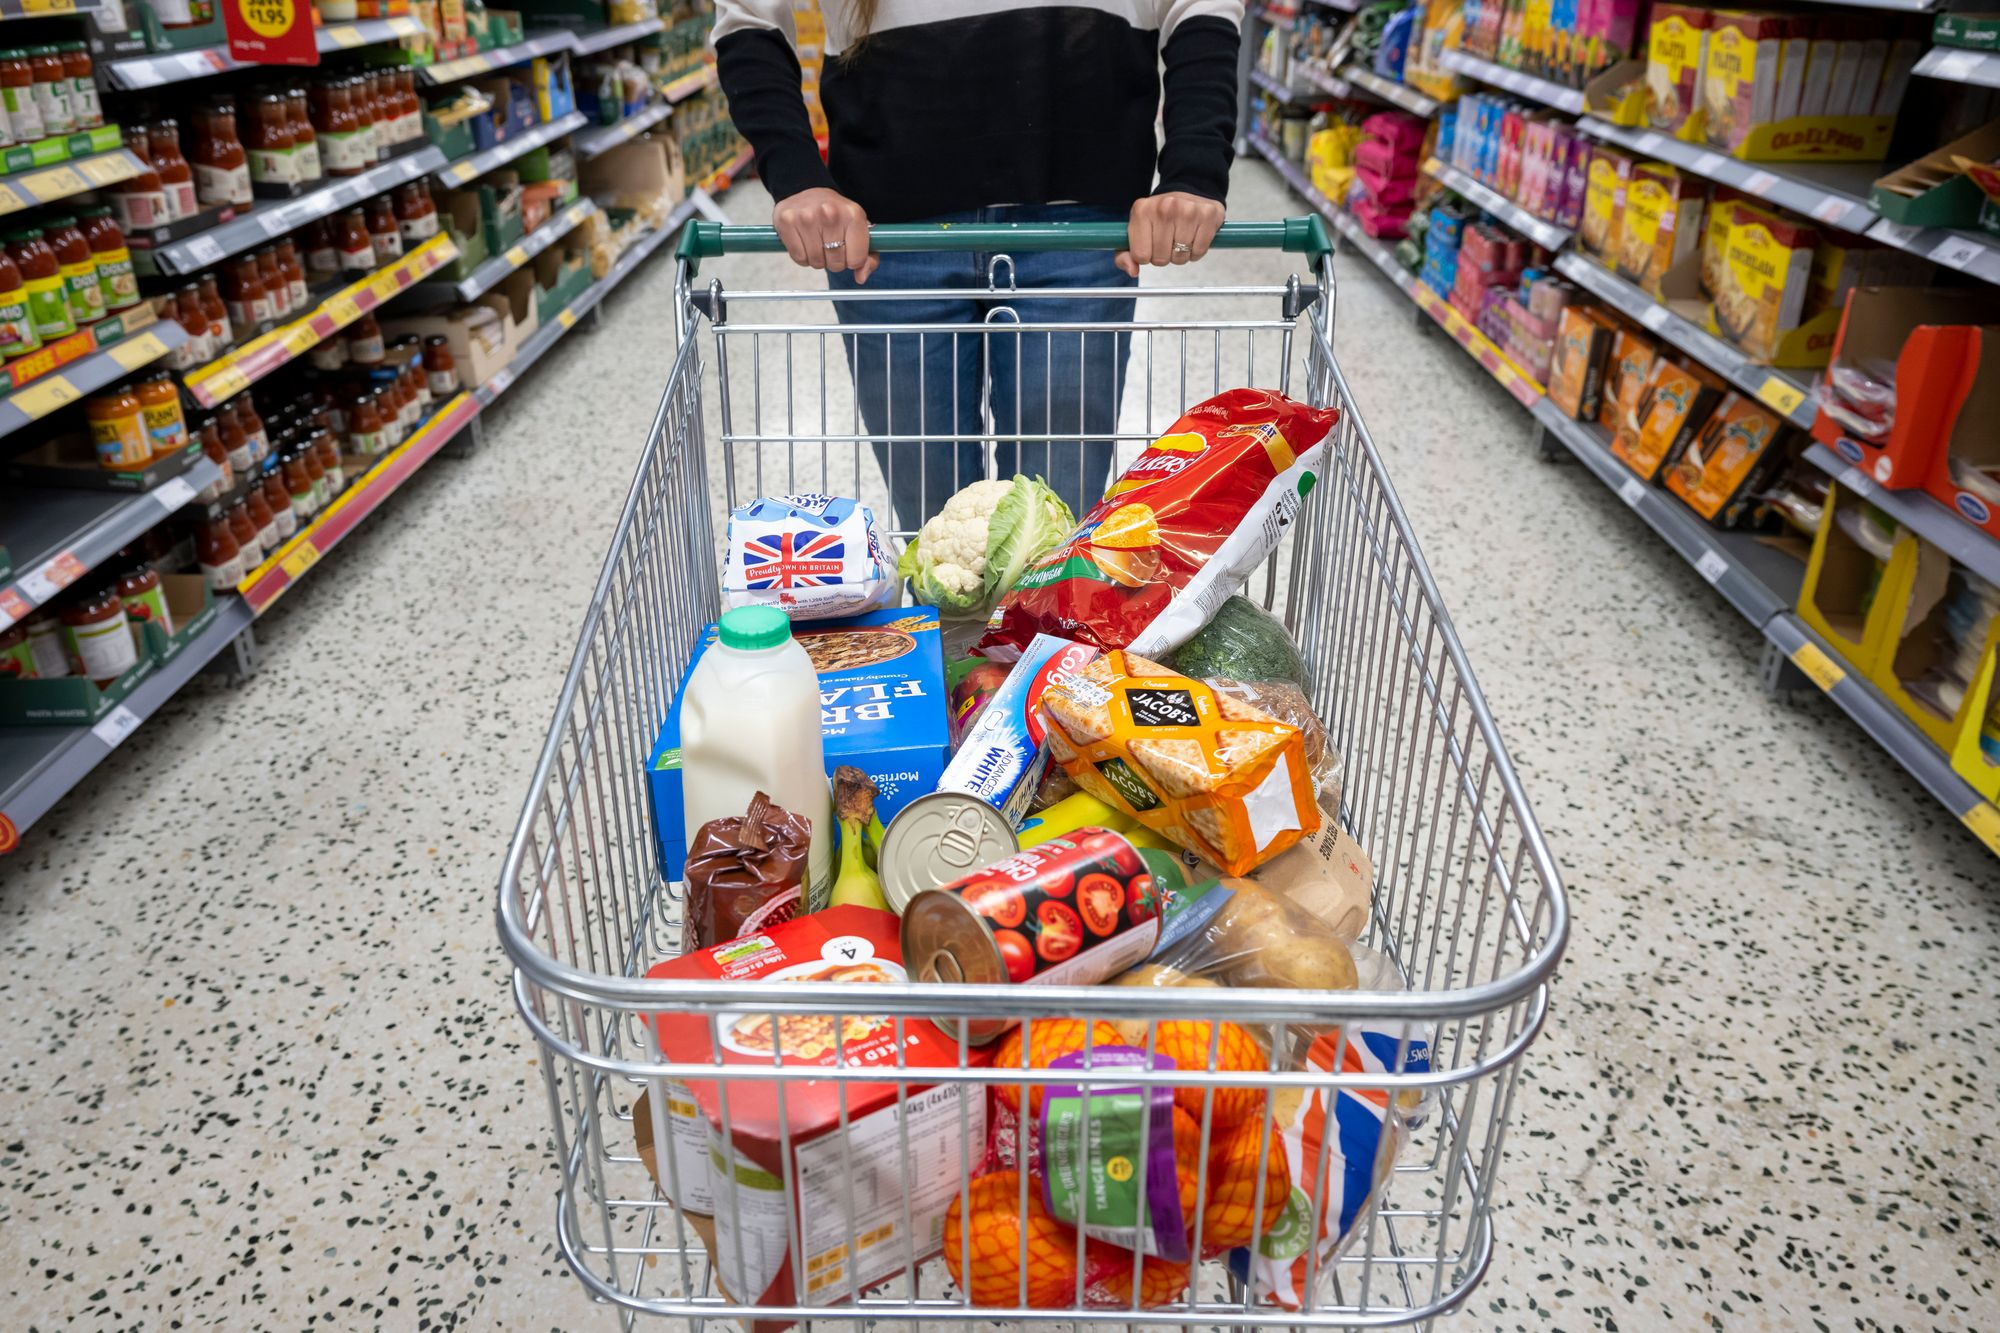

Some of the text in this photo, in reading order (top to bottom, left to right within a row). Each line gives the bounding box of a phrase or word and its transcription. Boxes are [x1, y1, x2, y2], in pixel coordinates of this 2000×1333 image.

[249, 8, 287, 25] £1.95
[15, 350, 55, 382] FREE
[748, 564, 781, 578] Proudly
[864, 673, 909, 681] Crunchy
[820, 680, 928, 706] FLA
[821, 701, 895, 725] BR
[1131, 693, 1192, 723] JACOB'S
[868, 770, 919, 782] Morriso
[963, 746, 1006, 793] WHITE
[980, 750, 1014, 797] ADVANCED
[1104, 767, 1157, 804] JACOB'S
[840, 947, 857, 960] 4
[1089, 1118, 1108, 1211] TANGERINES
